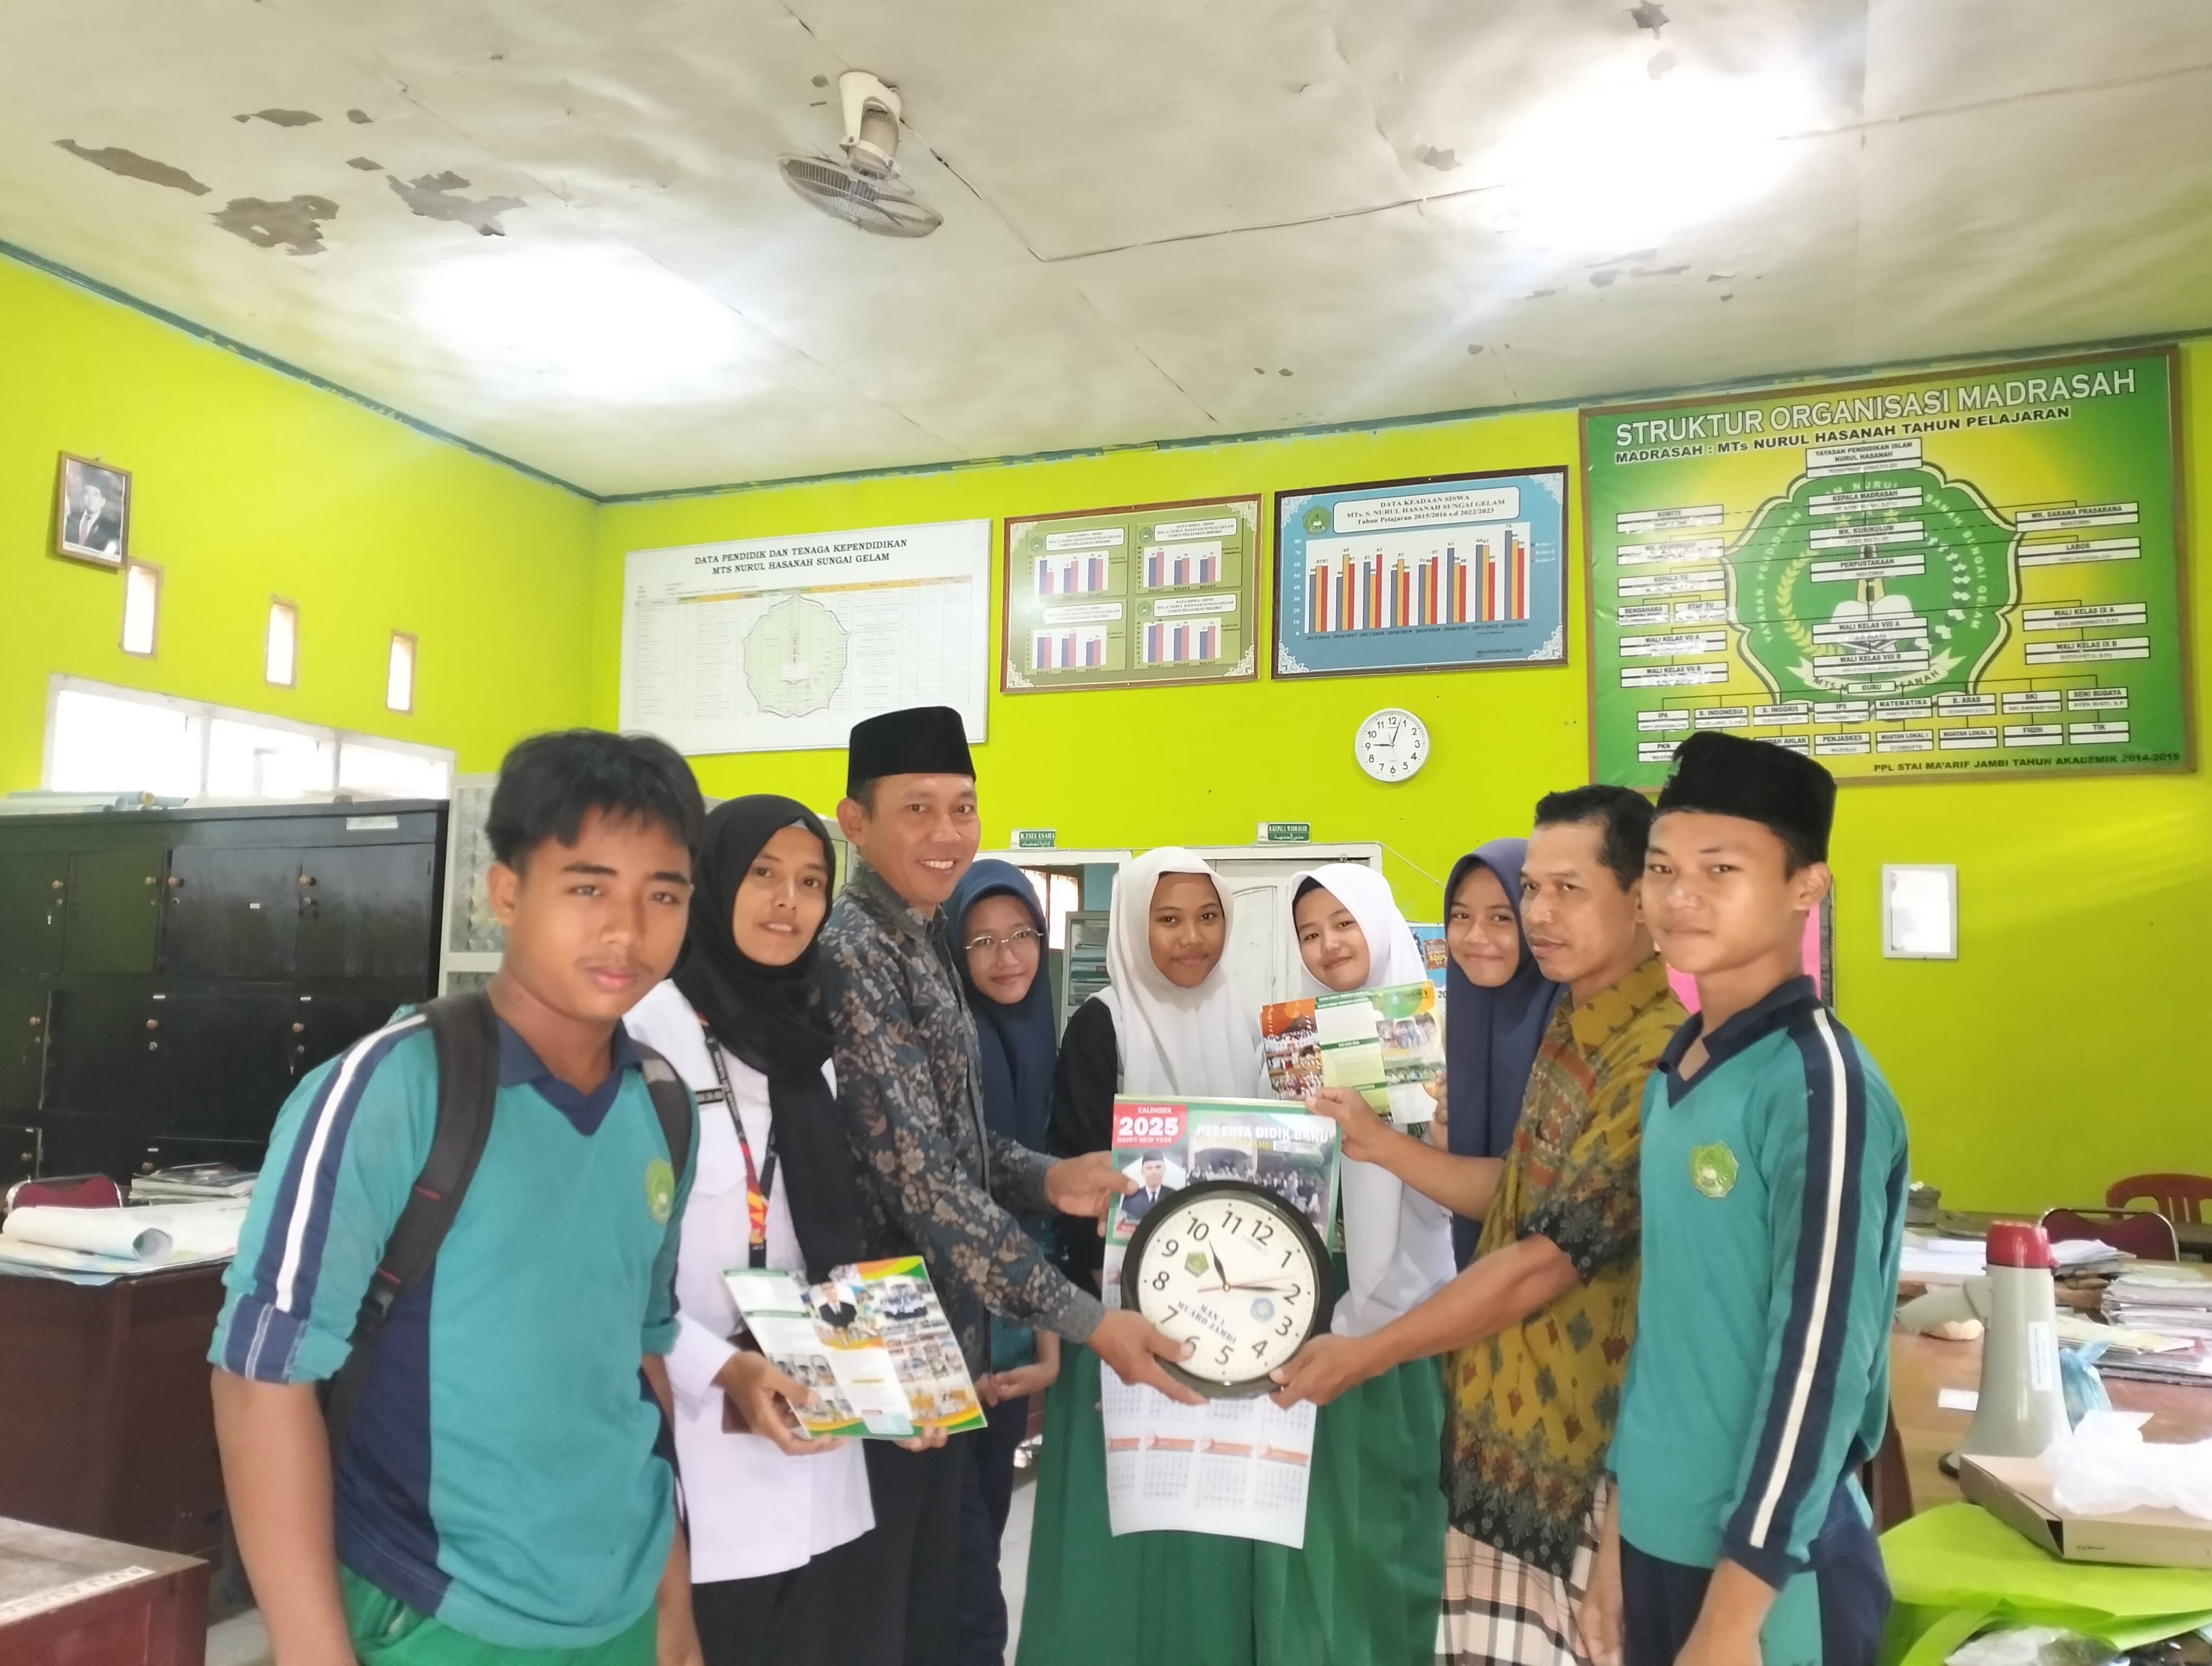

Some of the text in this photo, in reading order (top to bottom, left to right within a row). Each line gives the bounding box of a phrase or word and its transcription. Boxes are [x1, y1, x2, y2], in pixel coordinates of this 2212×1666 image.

[1615, 368, 2136, 446] STRUKTUR ORGANISASI MADRASAH
[1616, 445, 1703, 463] MADRASAH
[1718, 441, 1748, 453] MTs
[1753, 434, 1810, 450] NURUL
[1815, 425, 1896, 443] HASANAH
[1901, 419, 1960, 434] TAHUN
[1966, 406, 2070, 427] PELAJARAN
[1815, 448, 1848, 457] YAYASAN
[1847, 444, 1890, 453] PENDIDIKAN
[1860, 451, 1893, 460] HASANAH
[1404, 497, 1443, 506] KEADAAN
[1860, 490, 1898, 499] MADRASAH
[1373, 508, 1401, 516] NURUL
[1403, 505, 1441, 514] HASANAH
[1442, 502, 1474, 511] SUNGAI
[1475, 499, 1506, 508] GELAM
[2079, 505, 2123, 515] PRASARANA
[1380, 514, 1412, 524] Pelajaran
[1414, 511, 1447, 520] 2015/2016
[1460, 508, 1495, 516] 2022/2023
[1853, 524, 1894, 534] KURIKULUM
[695, 539, 907, 565] DATA PENDIDIK DAN TENAGA KEPENDIDIKAN
[2066, 542, 2091, 550] LABOR
[712, 553, 890, 574] MTS NURUL HASANAH SUNGAI GELAM
[1840, 558, 1895, 568] PERPUSTAKAAN
[1625, 606, 1663, 614] BENDAHARA
[1879, 699, 1927, 707] MATEMATIKA
[1388, 716, 1397, 725] 12
[1412, 727, 1417, 735] 2
[1365, 742, 1371, 751] 9
[1414, 740, 1420, 748] 3
[1368, 754, 1374, 763] 8
[1411, 752, 1417, 760] 4
[1926, 761, 1970, 770] MA'ARIF
[2056, 755, 2118, 764] AKADEMIK
[2121, 752, 2180, 762] 2014-2015
[1390, 765, 1396, 774] 6
[1403, 761, 1409, 770] 5
[1137, 1106, 1172, 1114] CALENDER
[1118, 1116, 1179, 1137] 2025
[1186, 1217, 1210, 1241] 10
[1221, 1211, 1243, 1234] 11
[1251, 1220, 1274, 1246] 12
[1161, 1239, 1179, 1257] 9
[1281, 1250, 1292, 1269] 1
[1152, 1271, 1170, 1291] 8
[1283, 1284, 1301, 1305] 2
[1160, 1305, 1179, 1324] 7
[1208, 1322, 1237, 1344] JAMBI
[1275, 1316, 1293, 1336] 3
[1214, 1344, 1234, 1365] 5
[1251, 1340, 1268, 1359] 4
